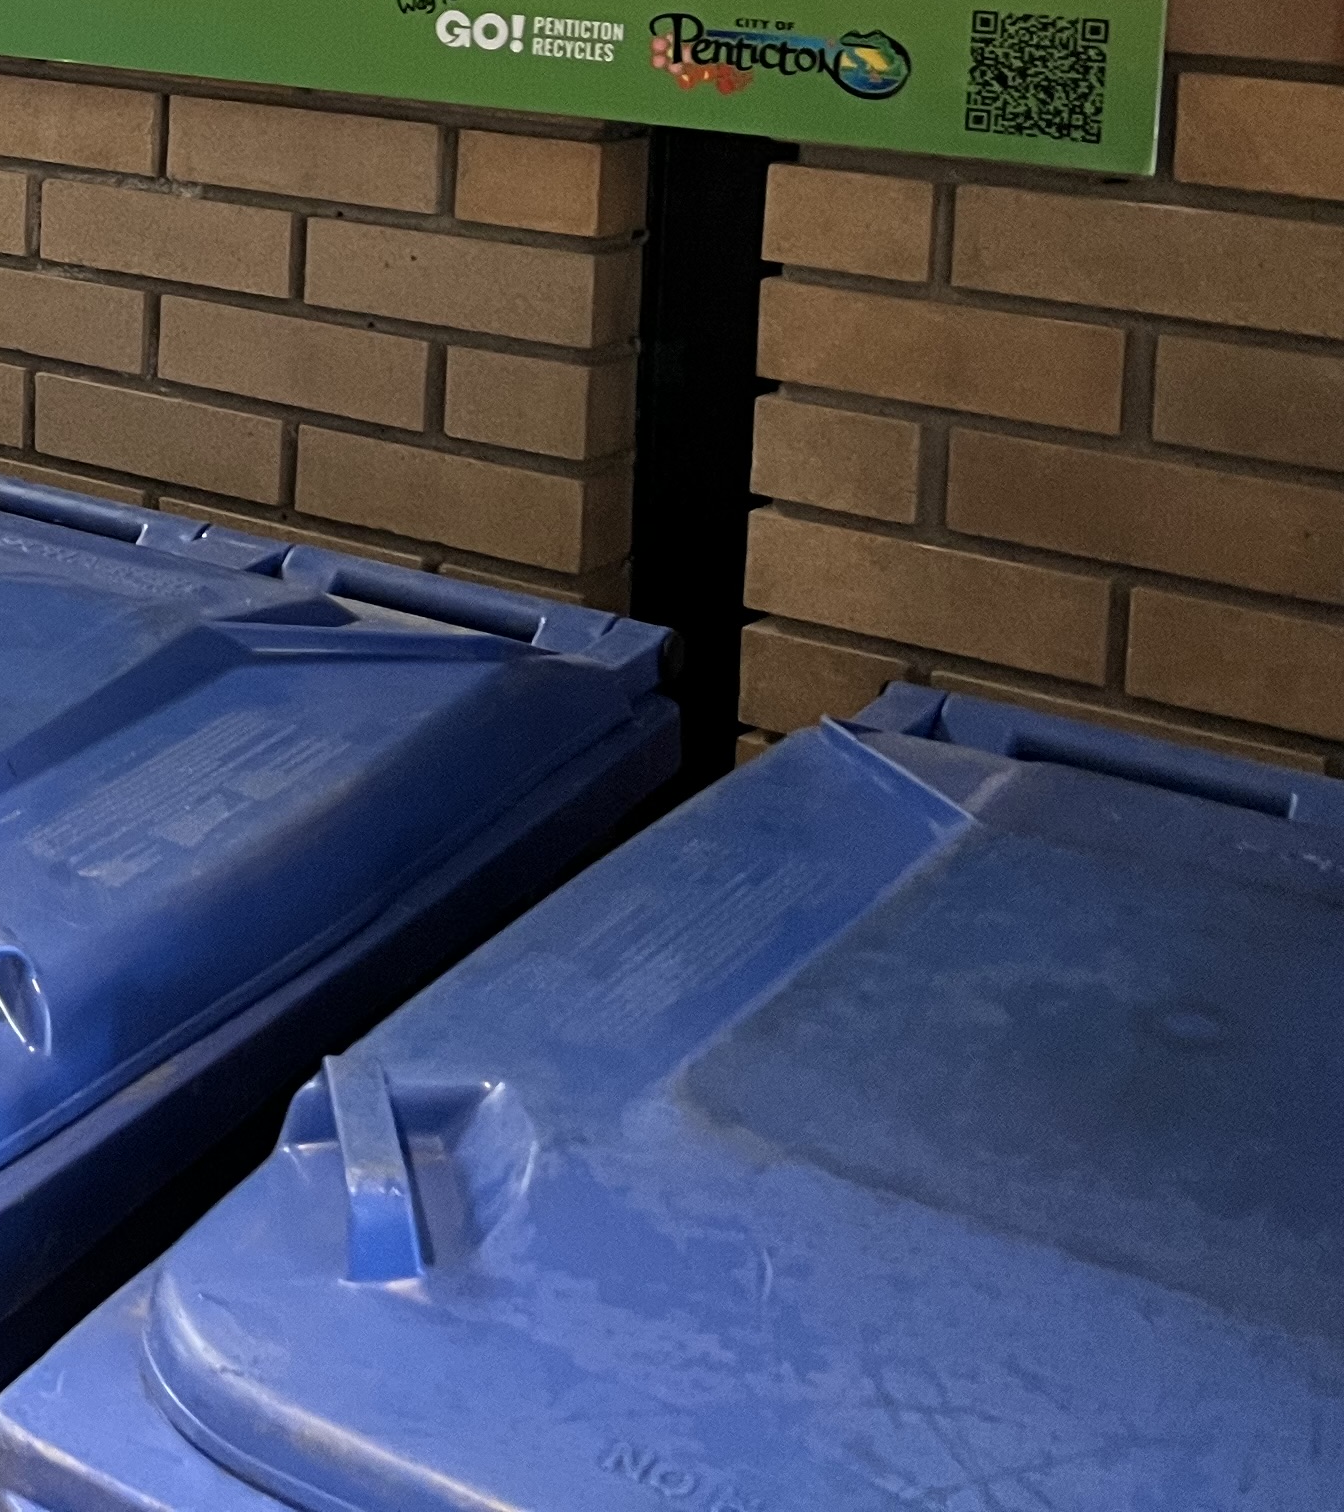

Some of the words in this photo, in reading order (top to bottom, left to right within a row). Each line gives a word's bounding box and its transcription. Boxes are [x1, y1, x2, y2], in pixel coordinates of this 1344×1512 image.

[434, 9, 526, 54] GO!
[533, 16, 625, 42] PENTICTON
[735, 17, 771, 30] CITY
[774, 20, 796, 32] OF
[531, 37, 615, 62] RECYCLES
